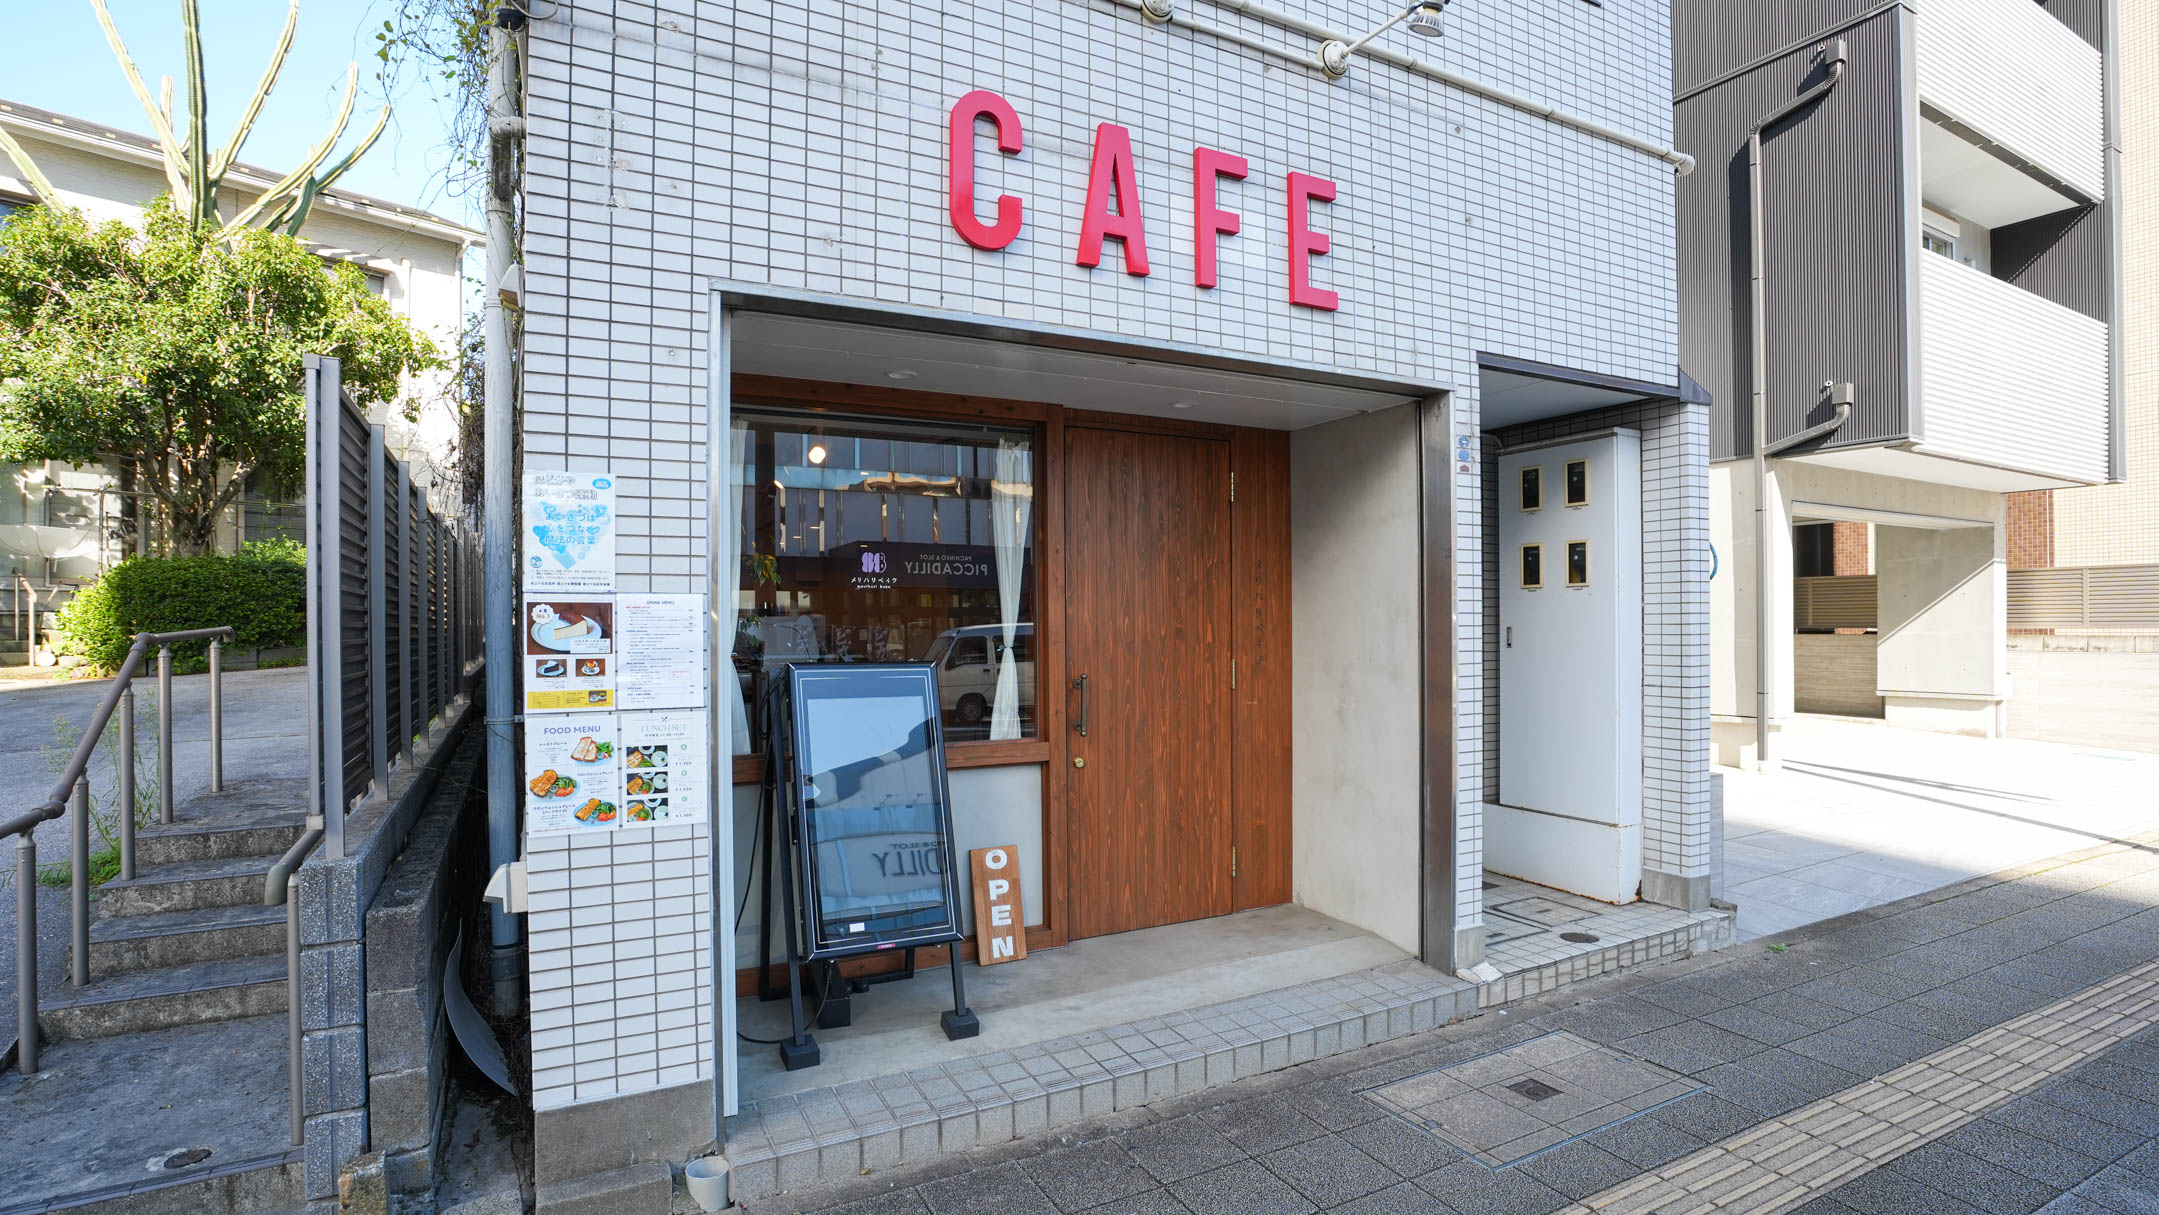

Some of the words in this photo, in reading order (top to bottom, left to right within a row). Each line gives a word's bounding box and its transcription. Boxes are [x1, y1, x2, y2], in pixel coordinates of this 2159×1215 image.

[949, 90, 1338, 312] CAFE
[543, 727, 572, 735] FOOD
[573, 725, 601, 734] MENU
[671, 723, 688, 732] SET
[985, 849, 1014, 959] OPEN
